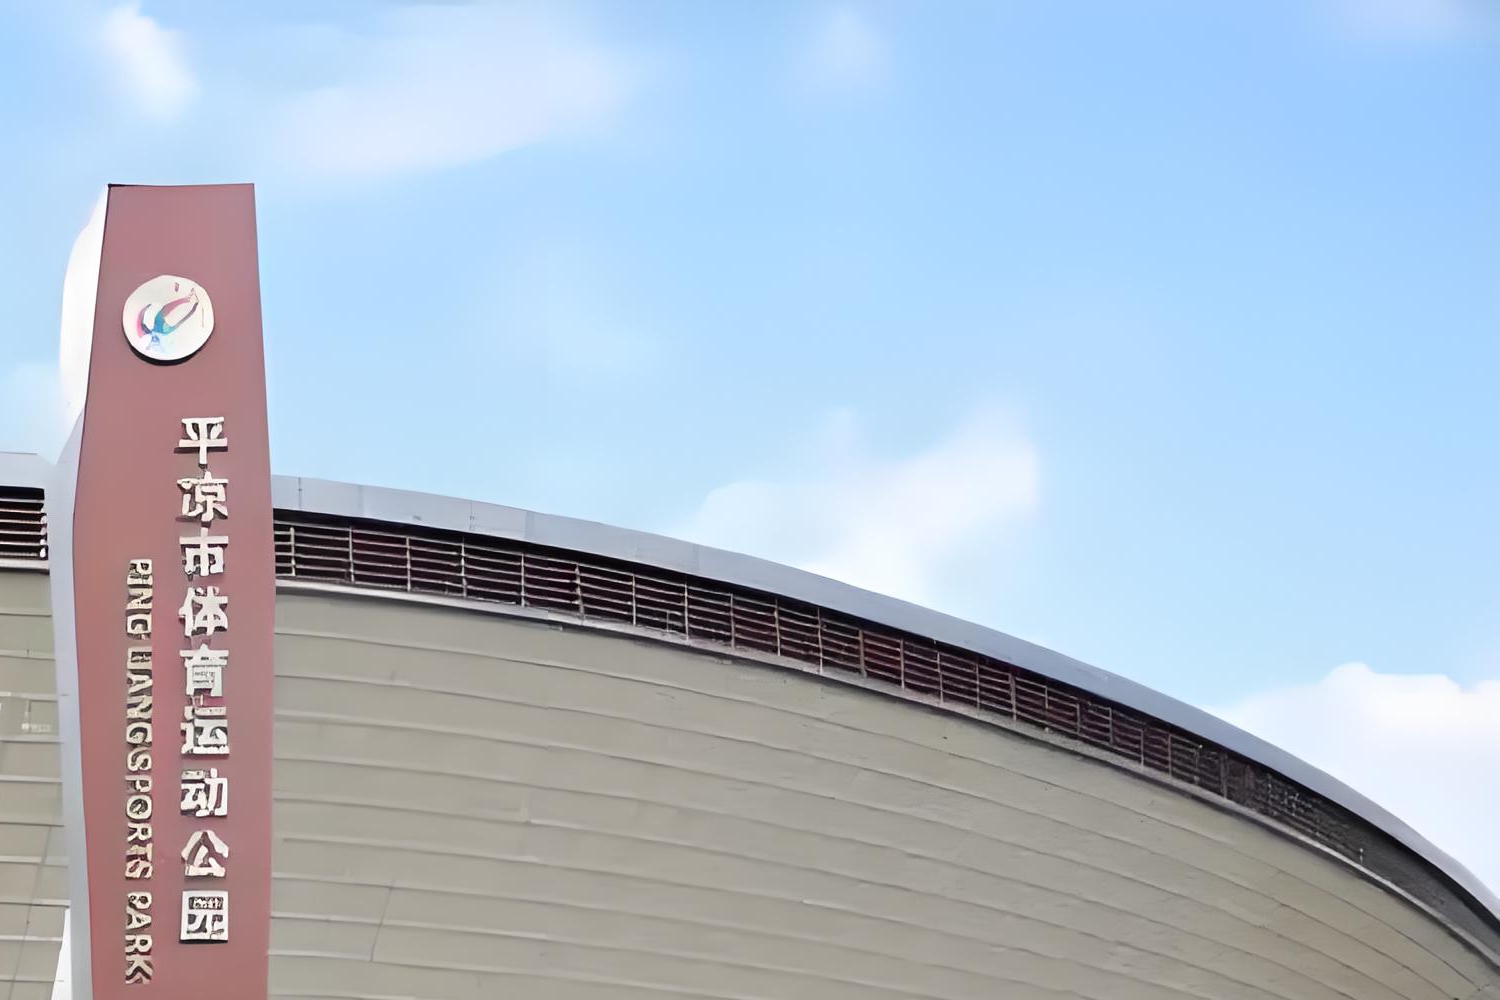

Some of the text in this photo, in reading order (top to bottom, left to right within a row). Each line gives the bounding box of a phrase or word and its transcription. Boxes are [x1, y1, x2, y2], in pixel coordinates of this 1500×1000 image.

[126, 559, 153, 638] PING
[177, 416, 230, 942] 平凉市体育运动公园
[125, 891, 153, 985] PARK
